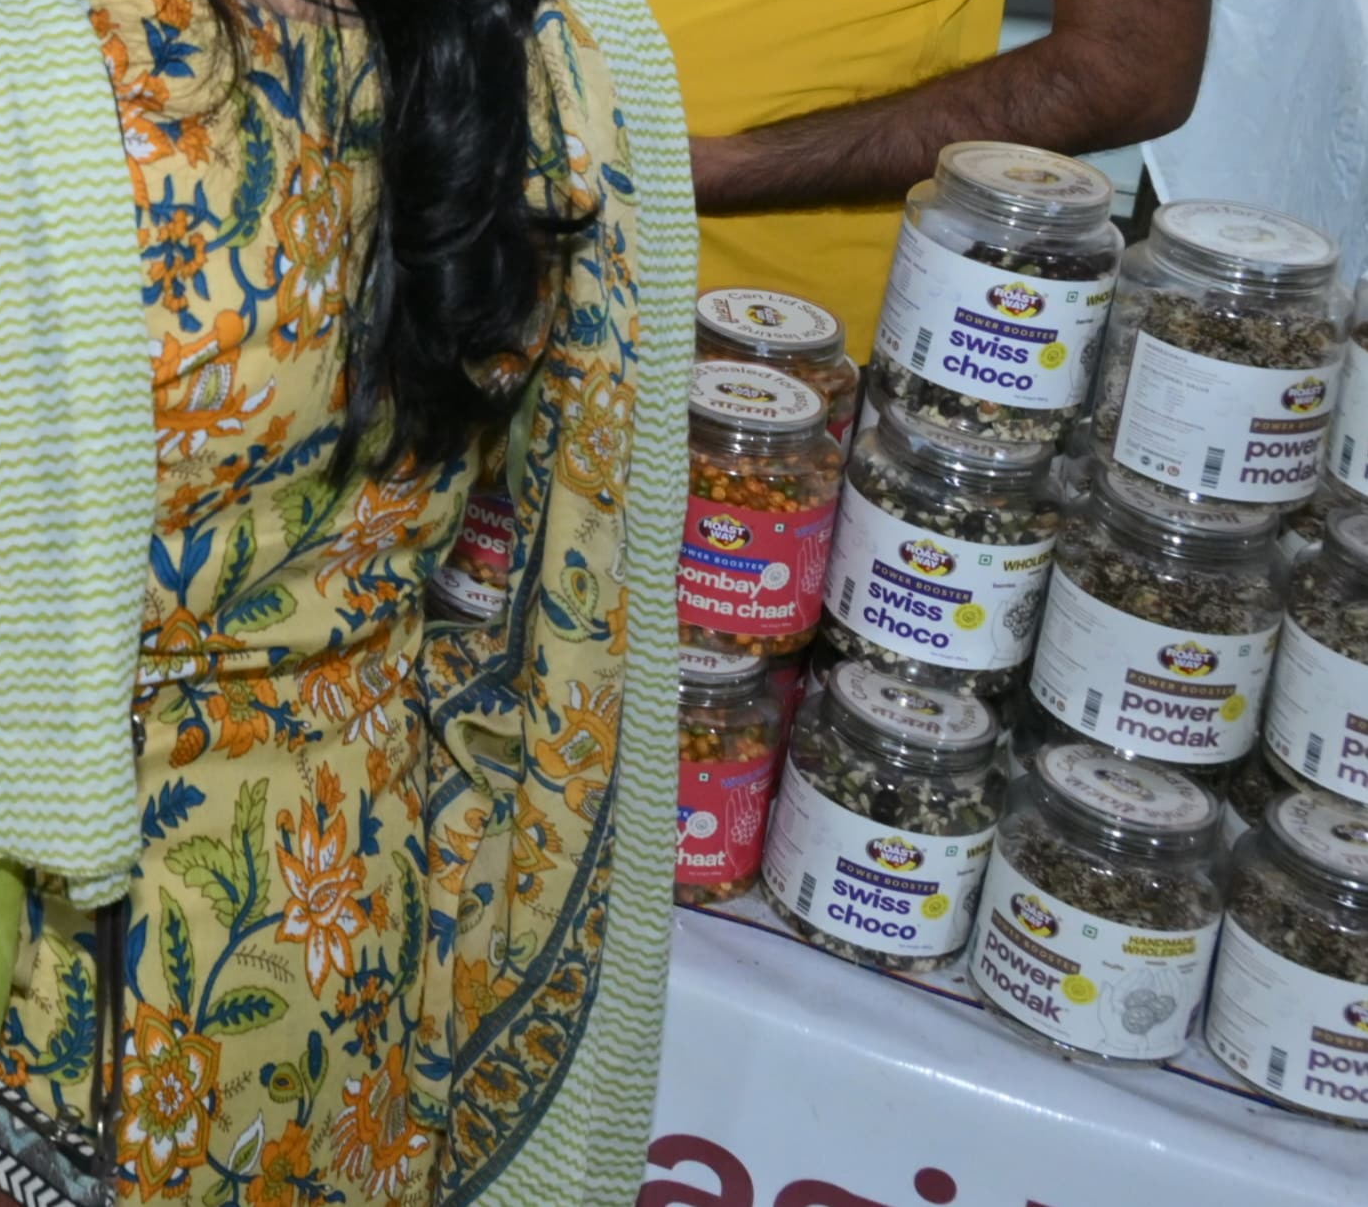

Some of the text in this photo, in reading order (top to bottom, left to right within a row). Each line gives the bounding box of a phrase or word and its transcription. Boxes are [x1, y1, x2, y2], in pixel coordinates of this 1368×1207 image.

[768, 294, 797, 307] Lid
[993, 286, 1039, 305] ROAST
[1000, 297, 1030, 312] WAY
[957, 310, 1056, 341] POWER BOOSTER
[949, 328, 1030, 365] swiss
[942, 354, 1033, 391] choco
[702, 518, 746, 536] ROAST
[709, 530, 736, 542] WAY
[714, 555, 764, 571] BOOSTER
[905, 543, 949, 564] ROAST
[912, 555, 939, 569] WAY
[874, 562, 971, 602] POWER BOOSTER
[677, 584, 797, 620] hana chaat
[868, 581, 944, 622] swiss
[863, 605, 950, 648] choco
[1166, 647, 1211, 663] ROAST
[1128, 671, 1176, 690] POWER
[1121, 690, 1220, 722] power
[1116, 715, 1220, 748] modak
[873, 840, 918, 859] ROAST
[880, 851, 908, 865] WAY
[839, 860, 937, 892] POWER BOOSTER
[832, 878, 911, 916] swiss
[827, 902, 917, 941] choco
[985, 929, 1060, 991] power
[980, 954, 1061, 1024] modak
[1309, 1048, 1368, 1077] pow
